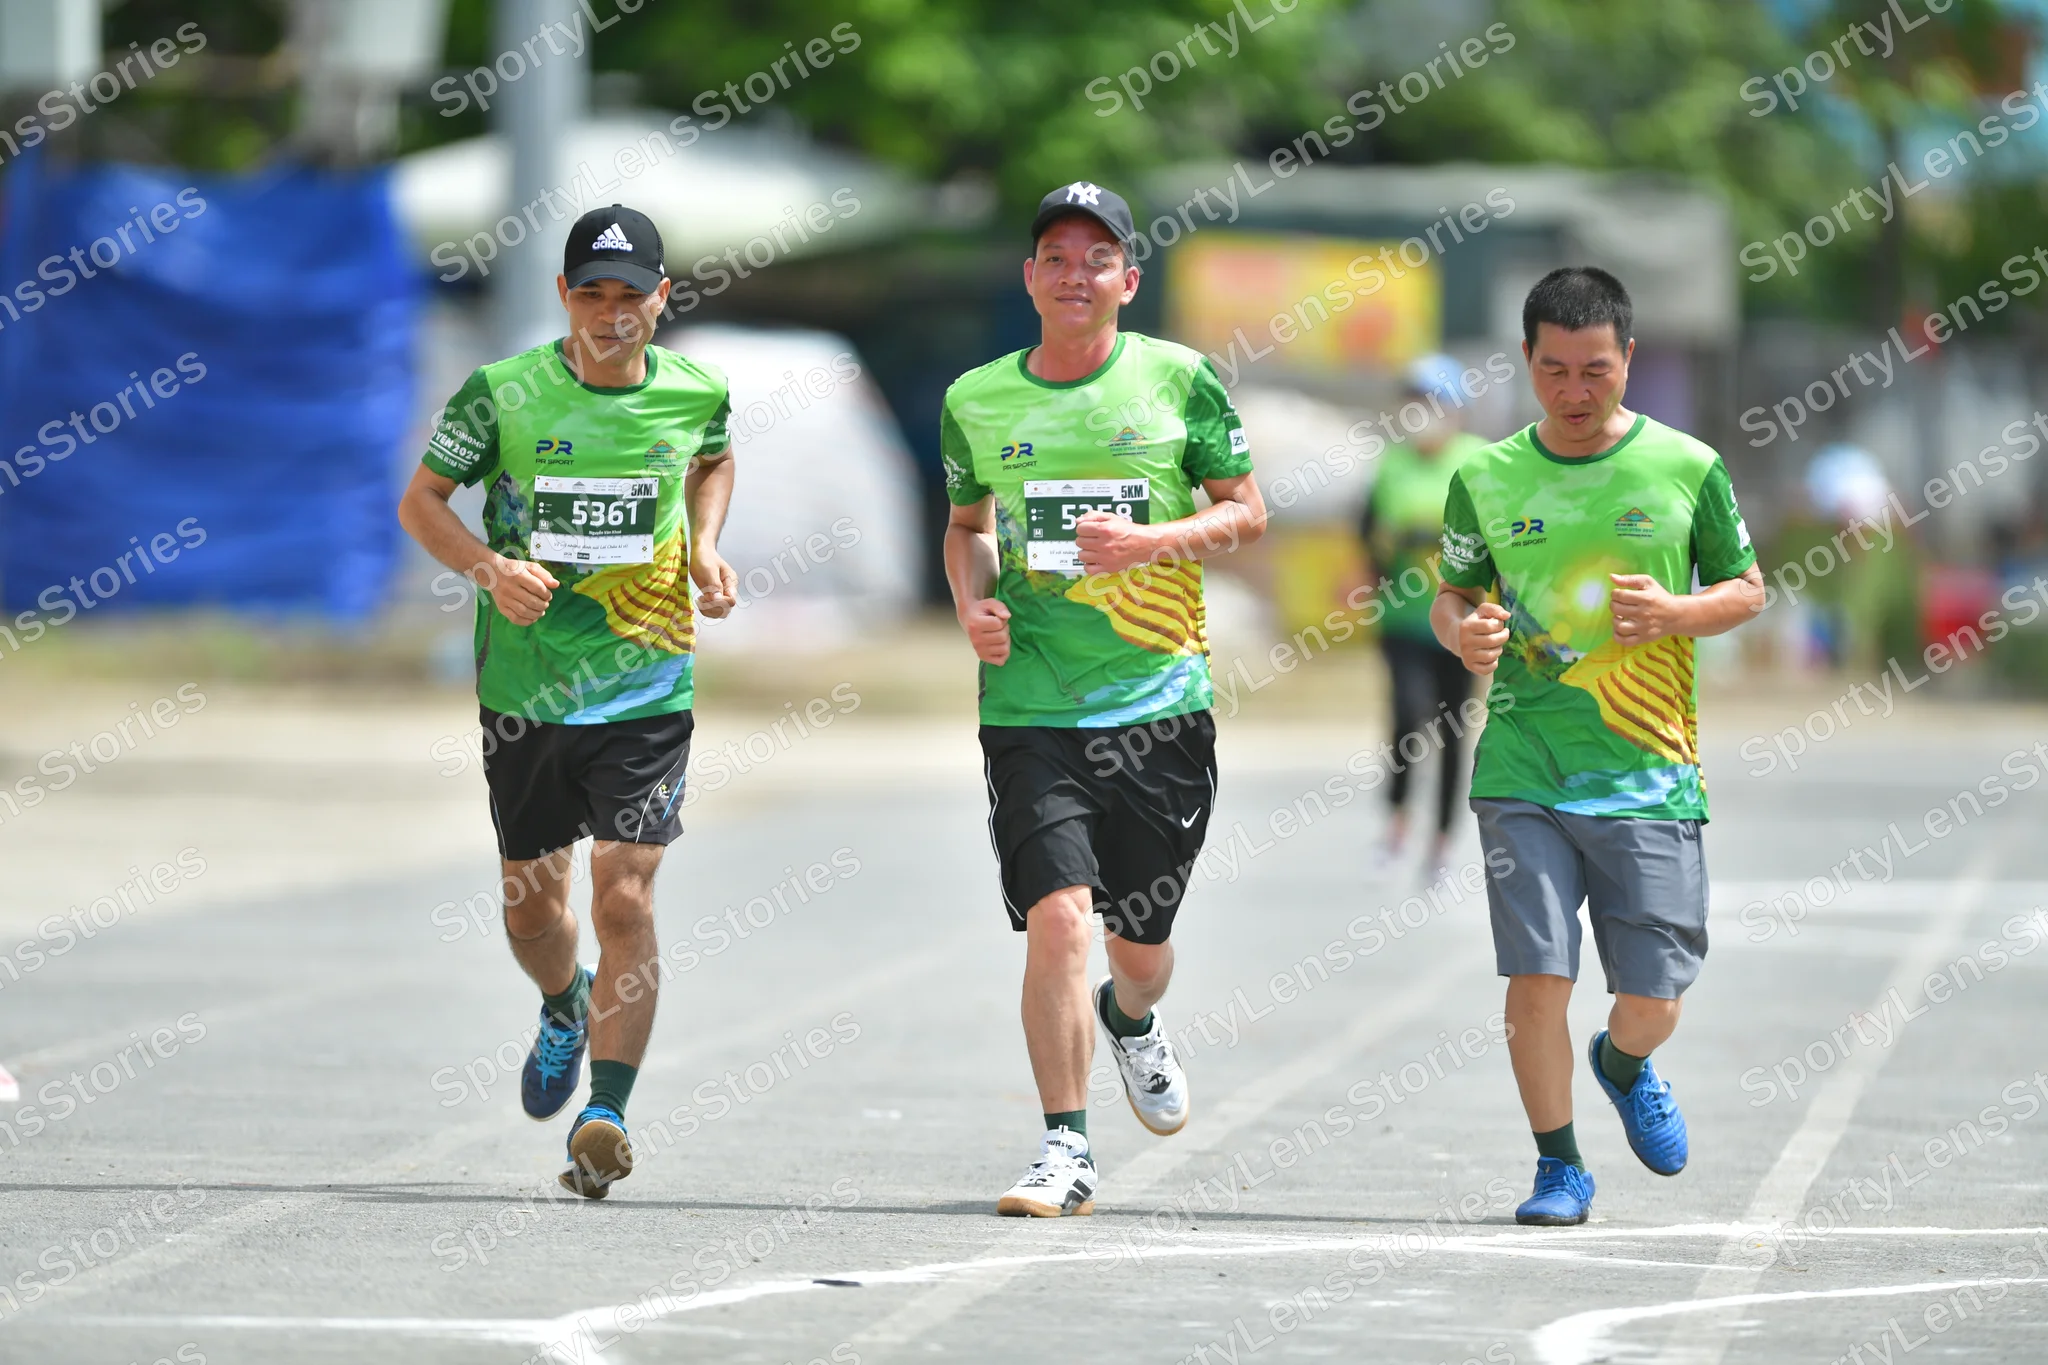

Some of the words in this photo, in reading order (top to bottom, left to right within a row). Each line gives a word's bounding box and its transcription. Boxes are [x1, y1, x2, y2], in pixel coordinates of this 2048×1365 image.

[592, 239, 633, 251] adidas
[452, 444, 480, 461] 2024
[536, 439, 573, 455] PR
[1001, 442, 1035, 460] PR
[631, 484, 653, 496] 5KM
[1121, 485, 1143, 498] 5KM
[572, 501, 638, 526] 5361
[1511, 518, 1545, 537] PR
[1522, 537, 1548, 546] SPORT
